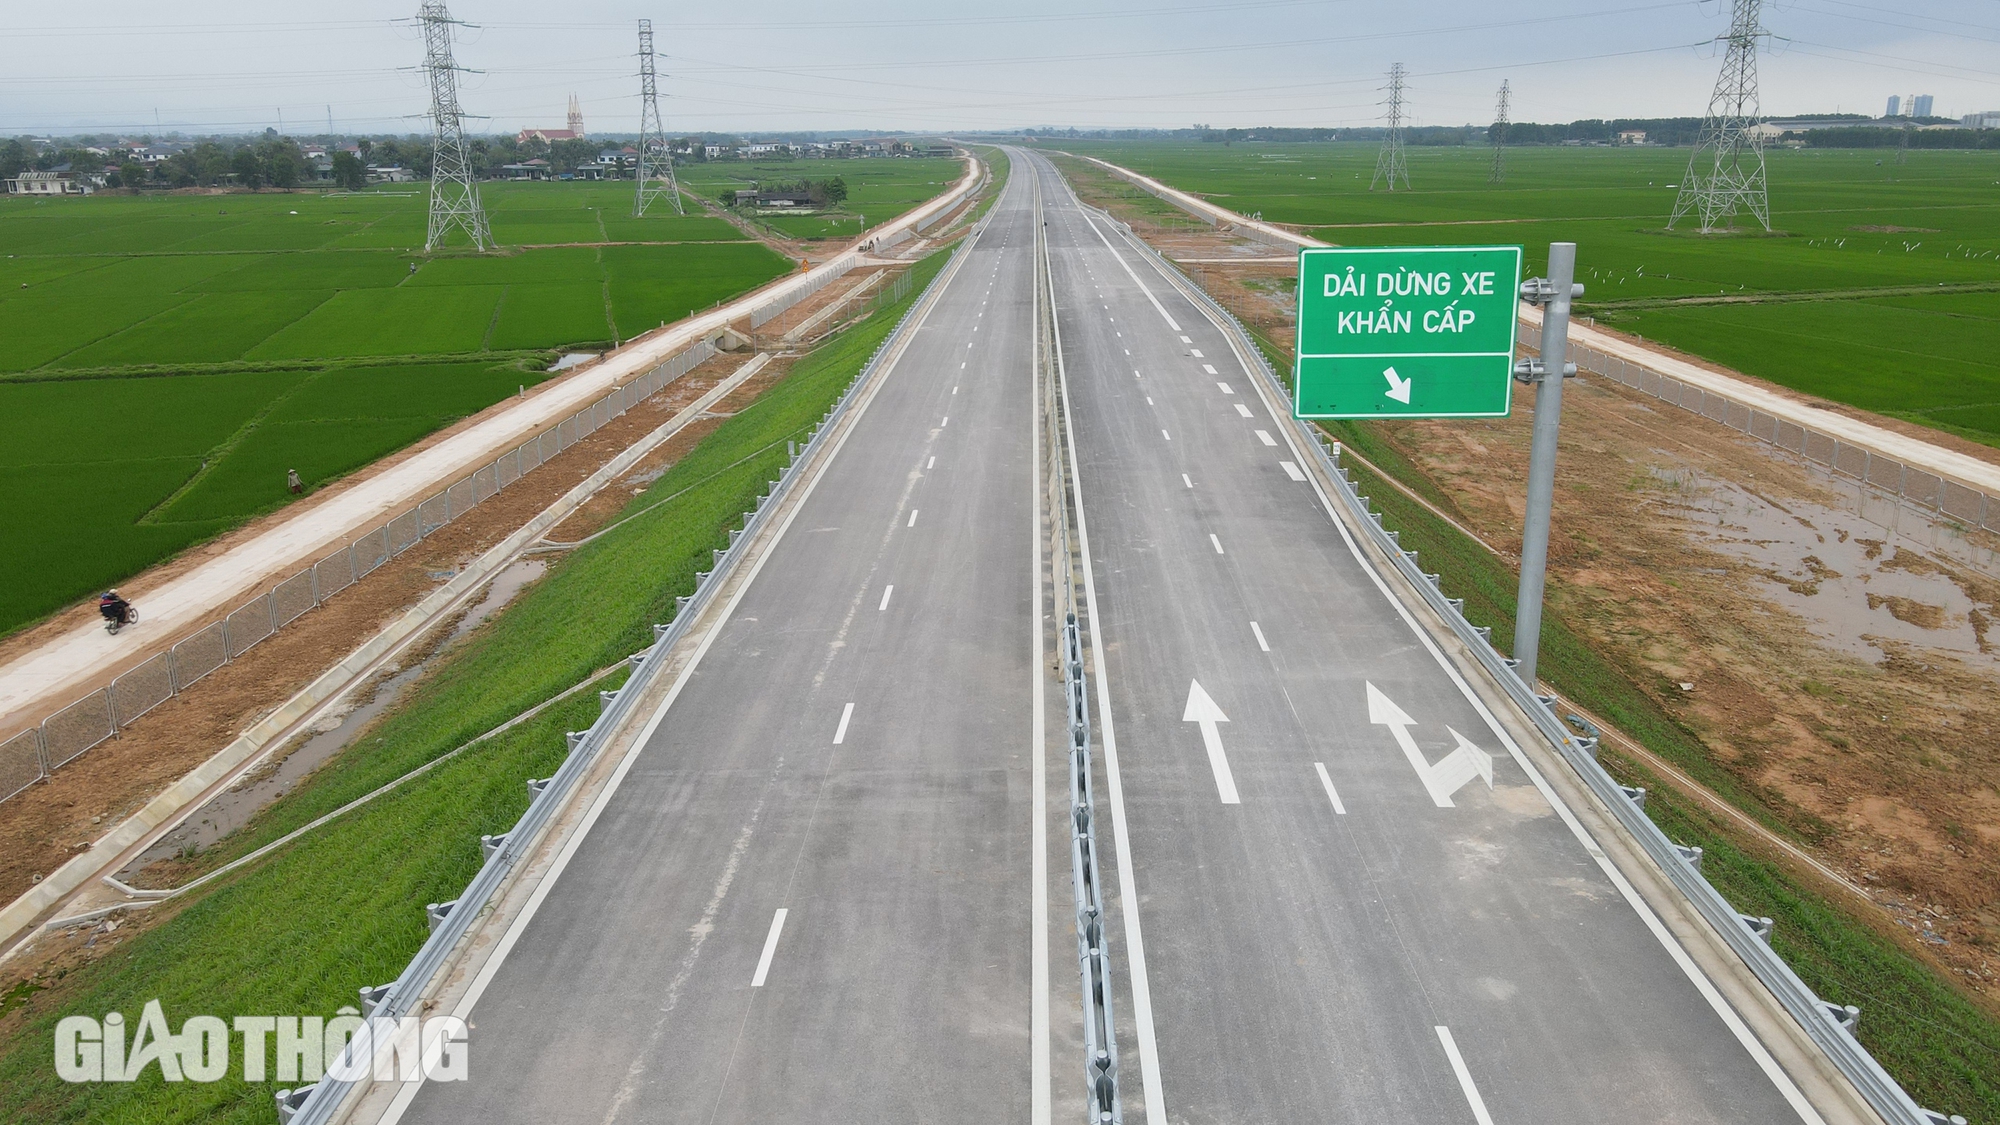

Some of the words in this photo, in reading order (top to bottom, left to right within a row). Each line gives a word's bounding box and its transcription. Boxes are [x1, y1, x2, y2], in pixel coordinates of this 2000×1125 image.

[1323, 266, 1366, 297] DẢI
[1377, 266, 1451, 297] DỪNG
[1461, 271, 1496, 296] XE
[1338, 299, 1411, 334] KHẨN
[1423, 299, 1475, 333] CẤP
